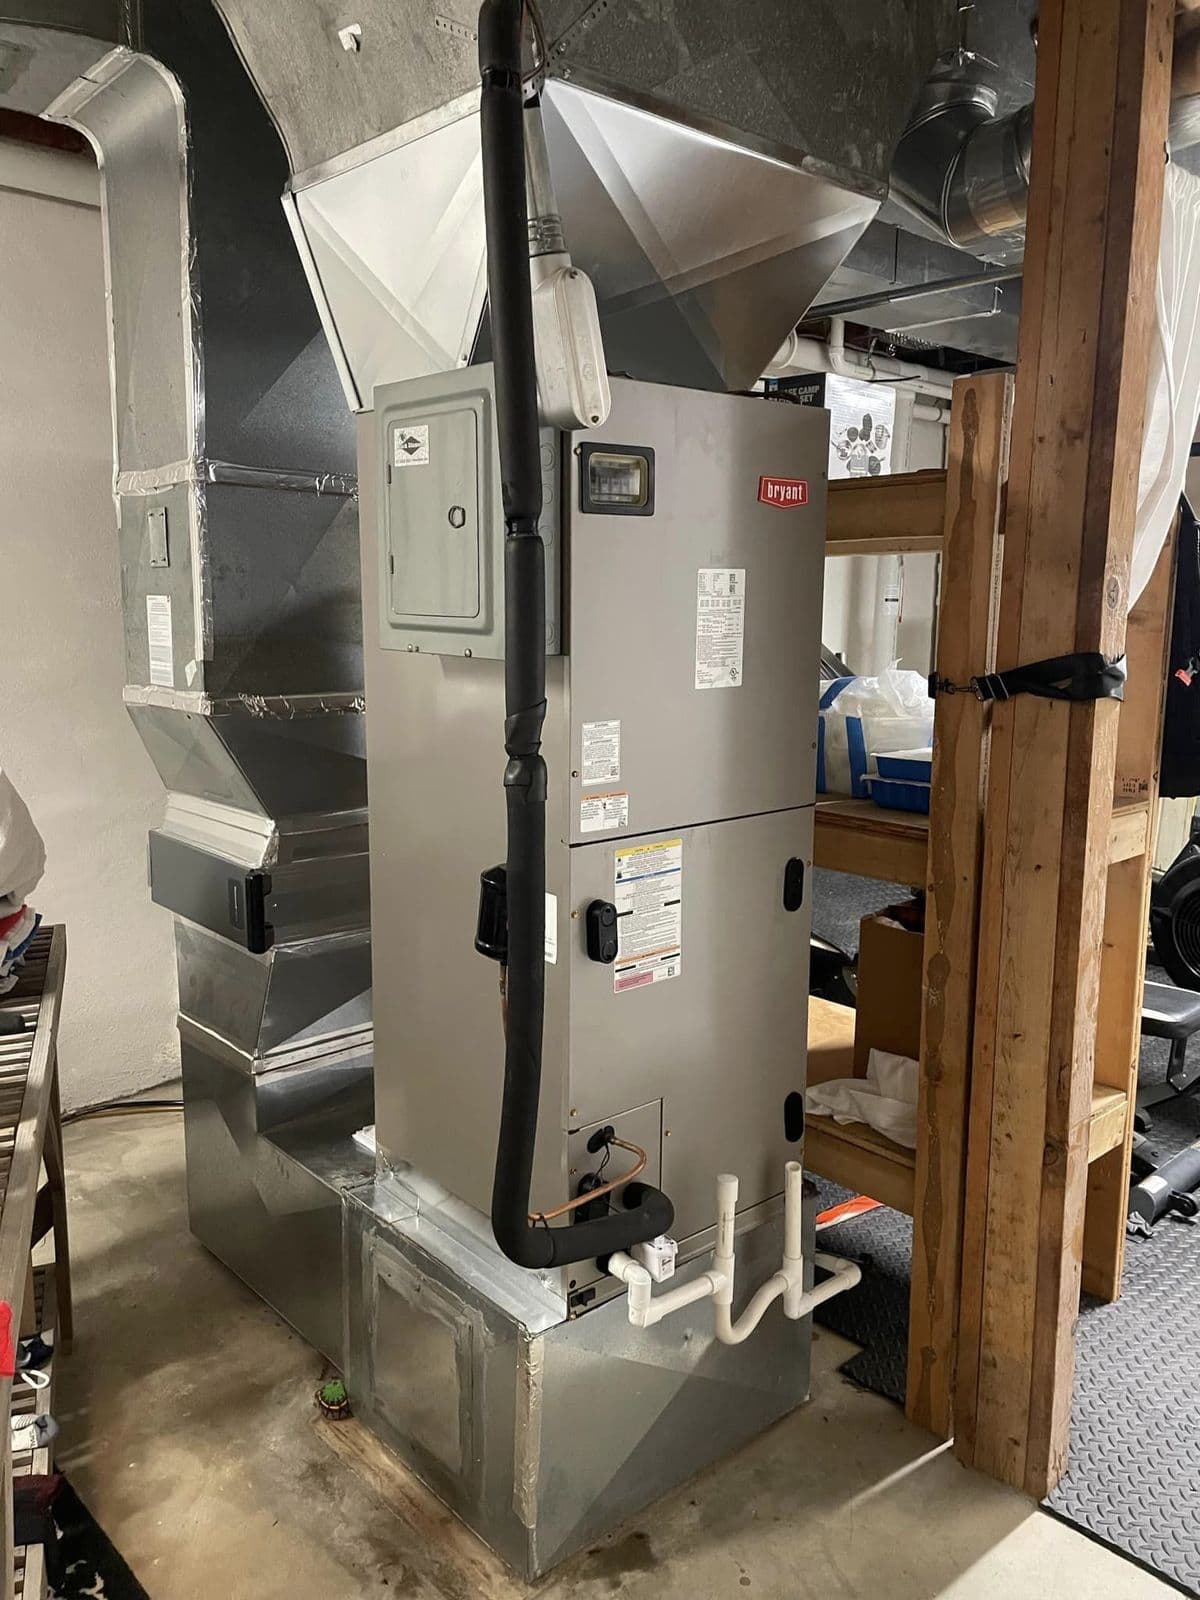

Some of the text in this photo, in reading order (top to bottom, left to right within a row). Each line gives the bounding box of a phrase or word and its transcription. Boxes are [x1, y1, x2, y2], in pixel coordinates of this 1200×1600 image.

[798, 385, 820, 395] CAMP
[800, 393, 814, 402] SET
[767, 481, 803, 502] bryant
